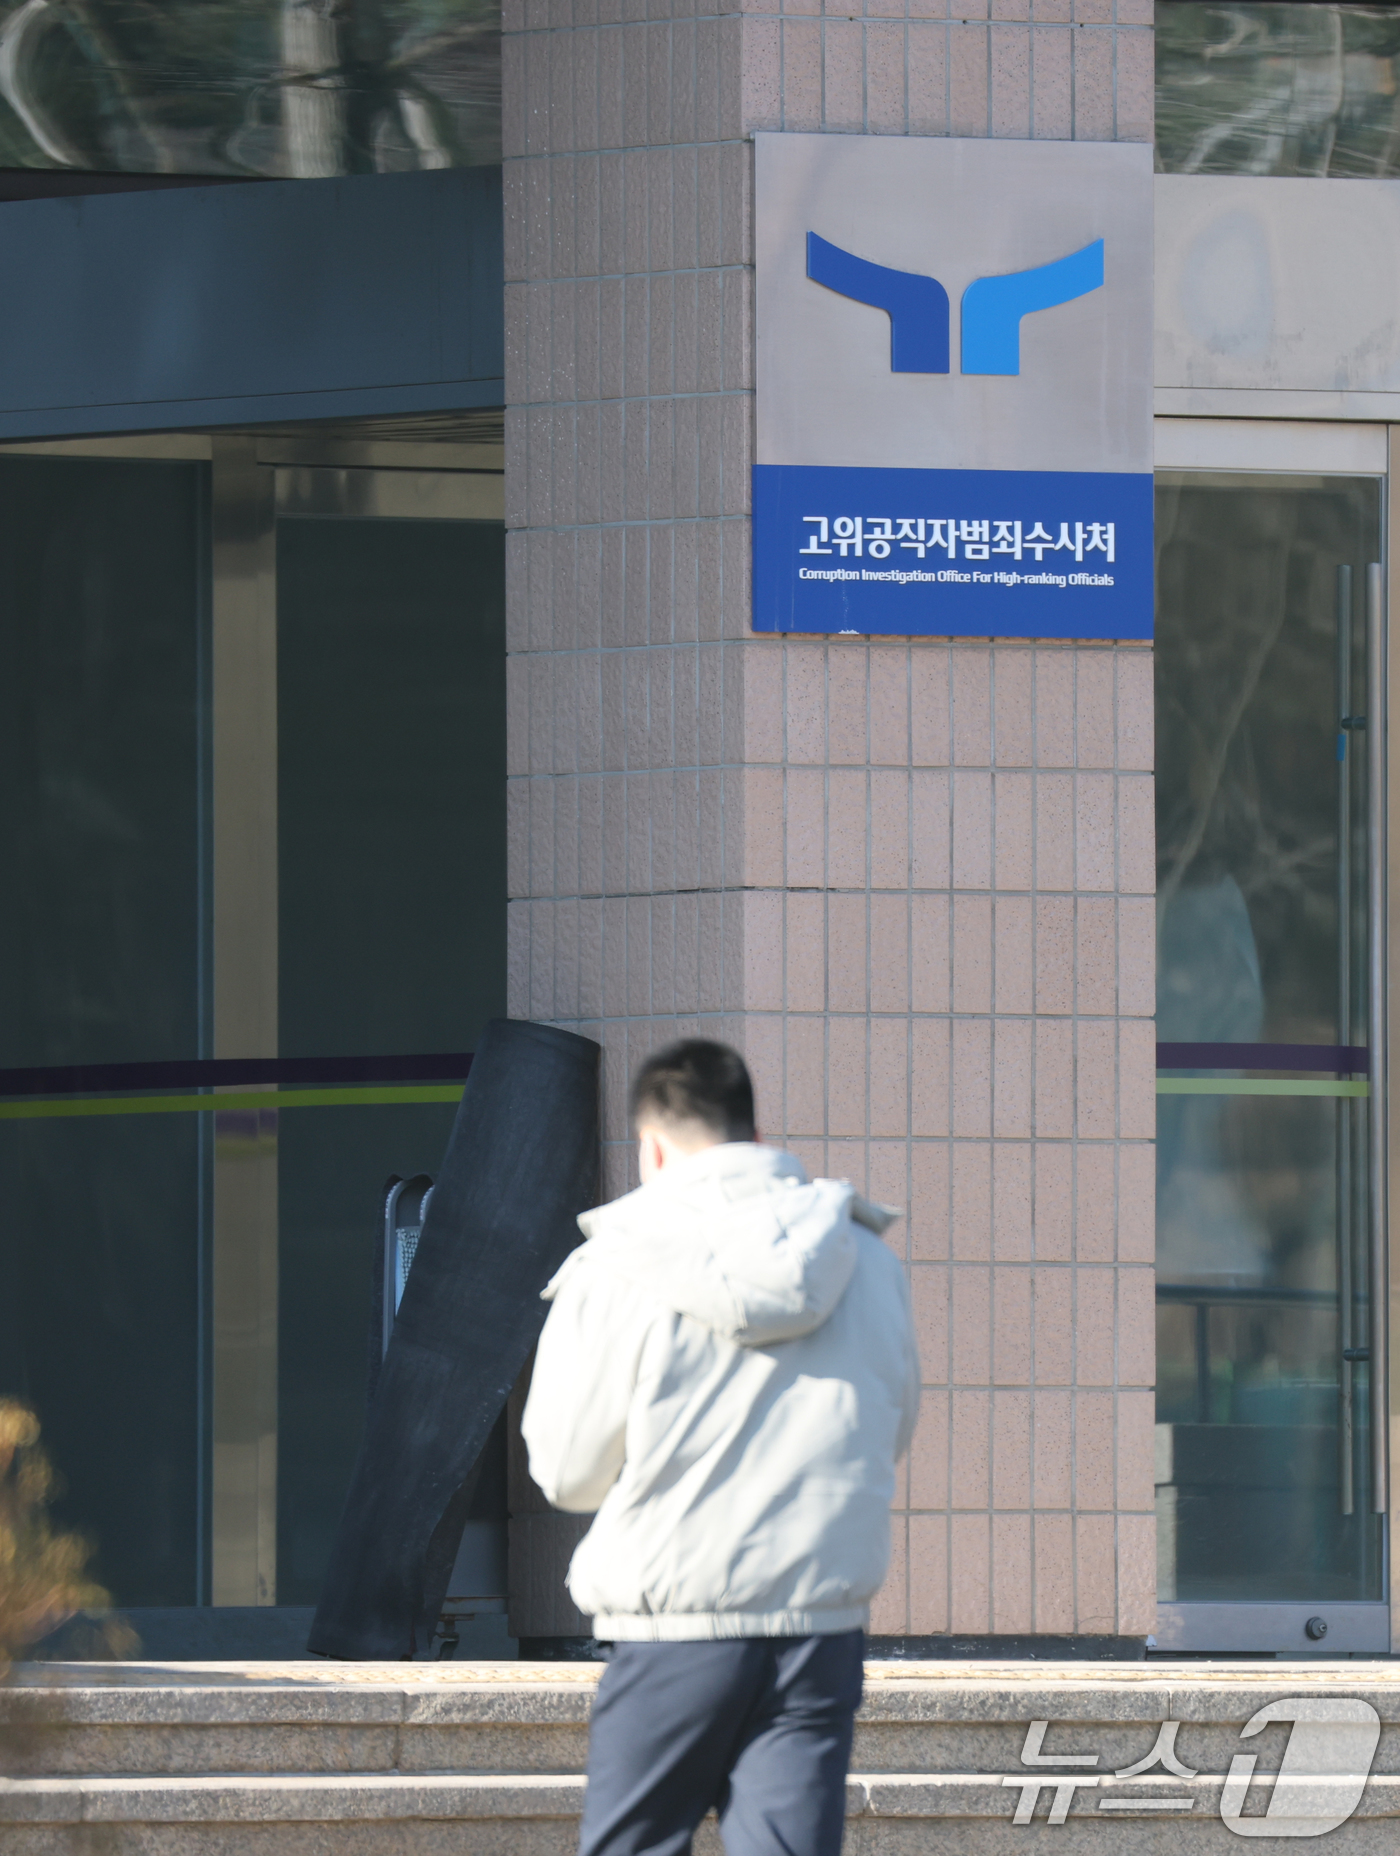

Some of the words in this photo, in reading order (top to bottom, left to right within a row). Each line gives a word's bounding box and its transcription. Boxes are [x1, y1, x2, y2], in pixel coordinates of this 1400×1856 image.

[799, 516, 1115, 562] 고위공직자범죄수사처
[799, 567, 860, 583] Corruption
[861, 569, 936, 585] Investigation
[937, 570, 971, 583] Office
[972, 571, 993, 583] For
[993, 571, 1067, 588] High-ranking
[1068, 573, 1115, 586] Officials
